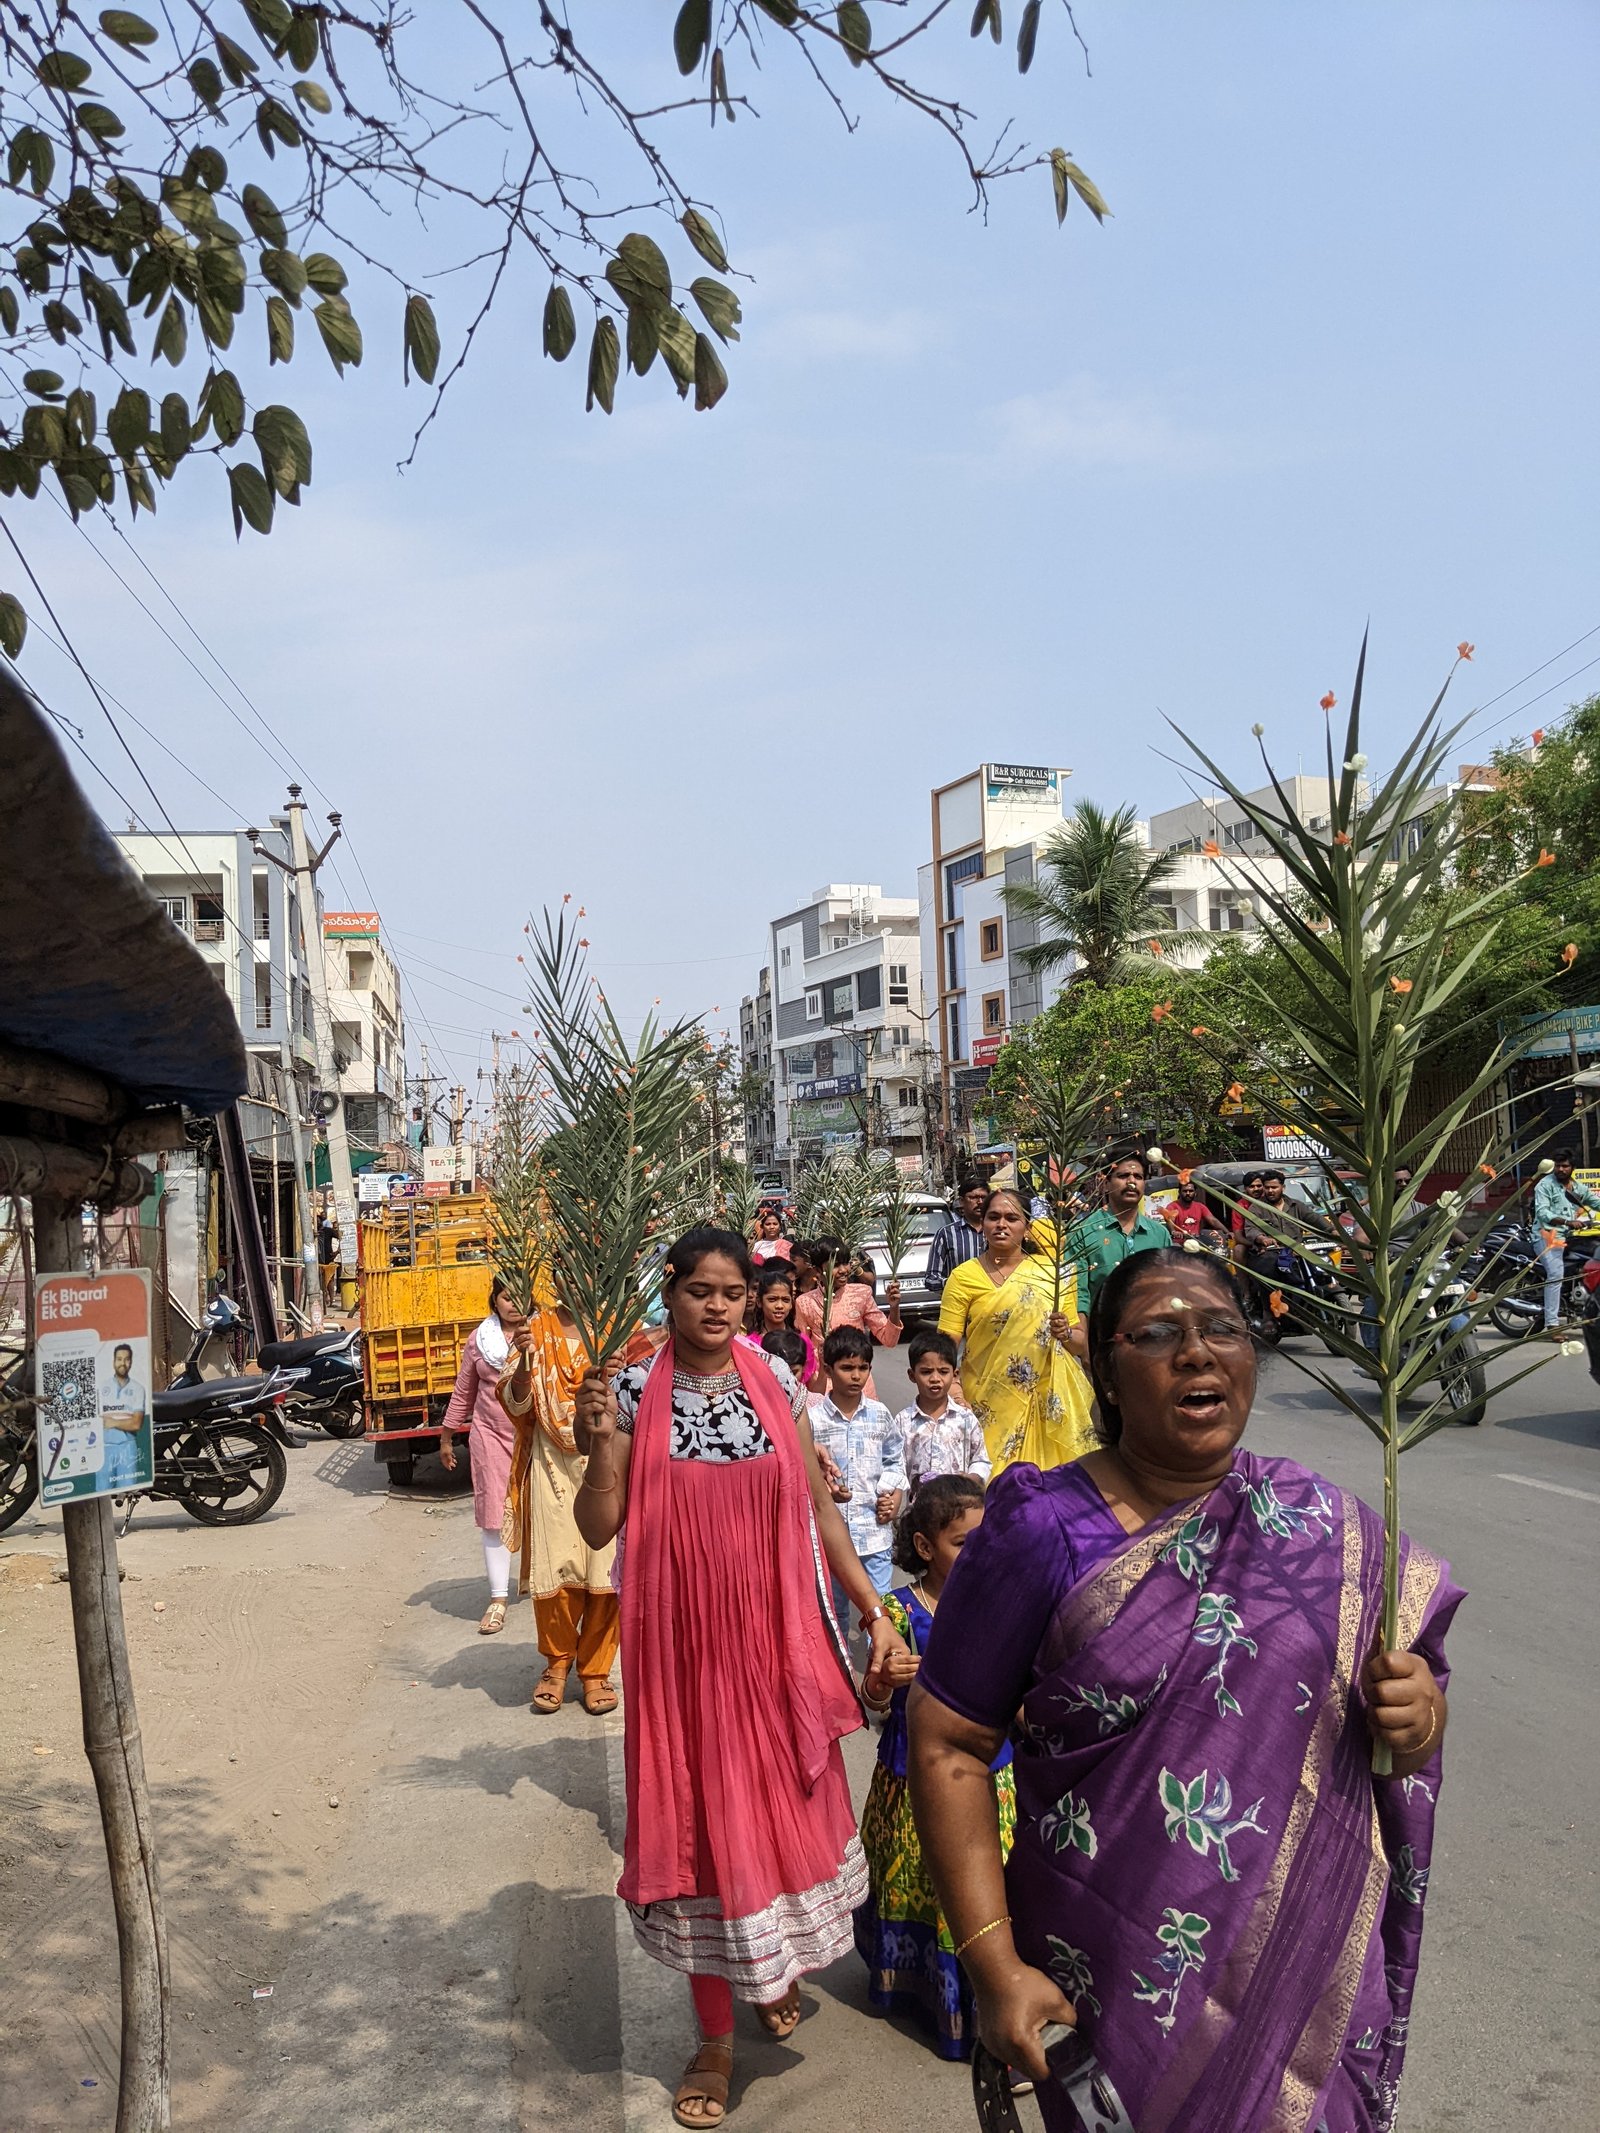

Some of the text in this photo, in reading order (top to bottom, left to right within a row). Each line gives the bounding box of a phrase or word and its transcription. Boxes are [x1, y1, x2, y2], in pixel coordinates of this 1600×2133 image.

[1010, 768, 1048, 779] SURGICALS
[1576, 1014, 1592, 1031] BIKE
[430, 1158, 467, 1167] TEA TIE
[41, 1285, 108, 1305] Ek Bharat
[41, 1303, 82, 1320] Ek QR
